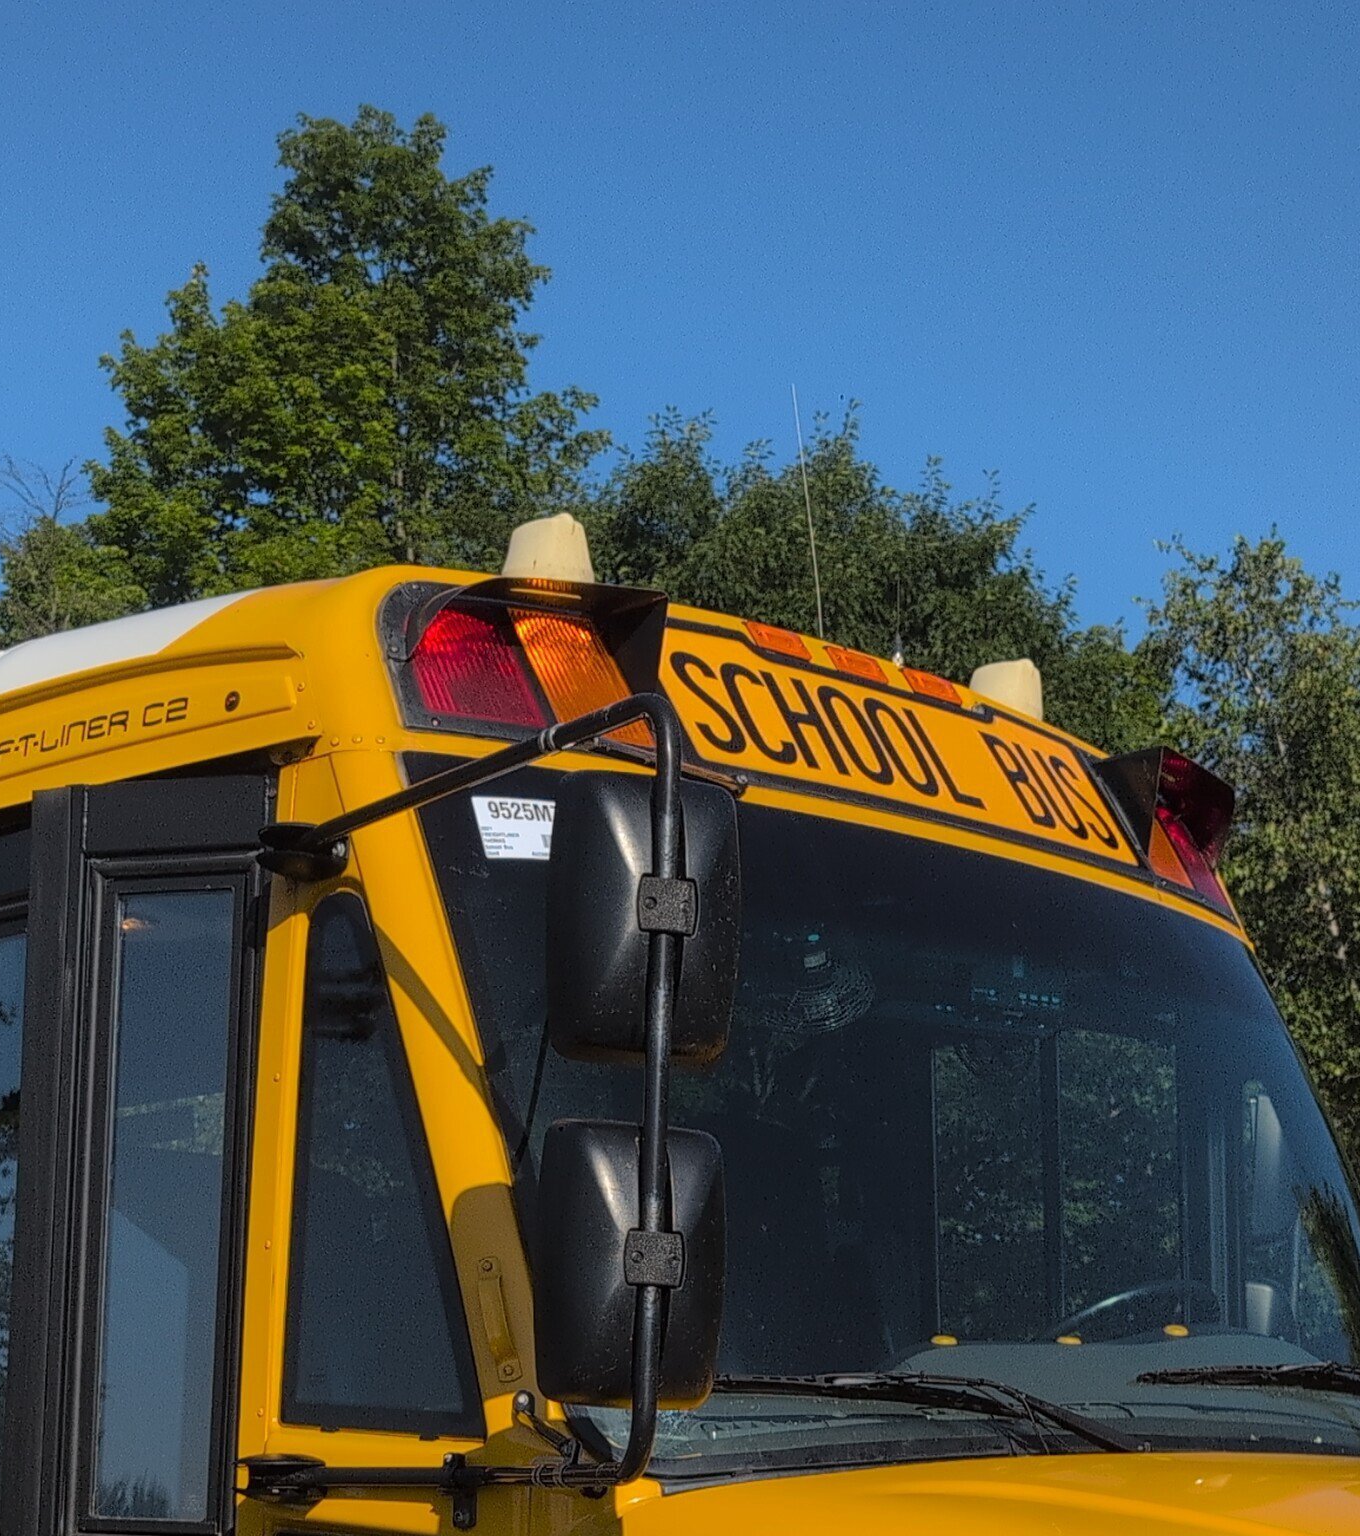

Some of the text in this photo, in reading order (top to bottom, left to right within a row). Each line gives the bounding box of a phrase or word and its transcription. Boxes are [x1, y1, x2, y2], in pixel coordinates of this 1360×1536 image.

[142, 697, 189, 727] C2
[670, 651, 1119, 849] SCHOOL BUS
[488, 801, 555, 822] 9525M
